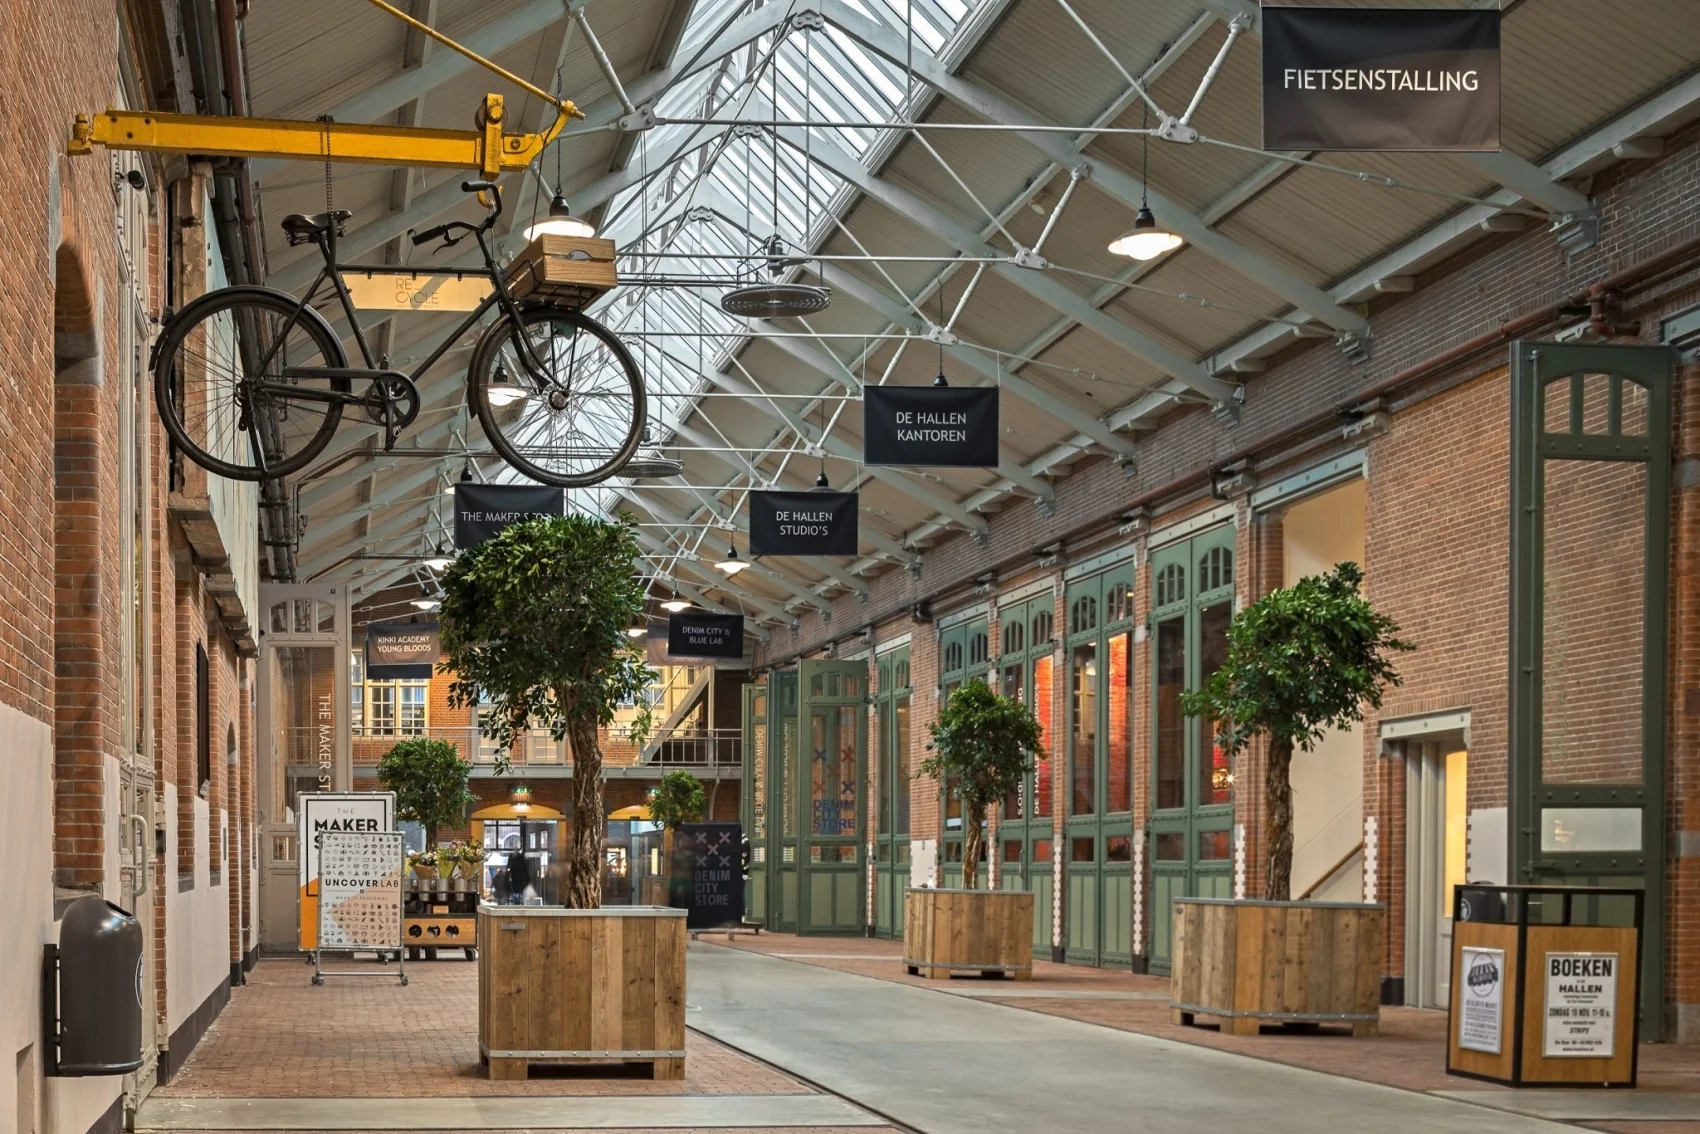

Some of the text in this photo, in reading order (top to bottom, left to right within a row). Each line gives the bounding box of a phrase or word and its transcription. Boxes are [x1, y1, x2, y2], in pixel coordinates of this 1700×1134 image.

[1284, 68, 1479, 91] FIETSENSTALLING
[396, 291, 439, 304] CYCLE
[896, 411, 967, 425] DE HALLEN
[897, 429, 966, 442] KANTOREN
[461, 511, 482, 522] THE
[485, 511, 521, 522] MAKER
[776, 511, 833, 522] DE HALLEN
[780, 525, 828, 536] STUDIO'S
[682, 626, 730, 636] DENIM CITY &
[377, 635, 431, 644] KINKI ACADEMY
[689, 636, 723, 645] BLUE LAB
[377, 644, 431, 653] YOUNG BLOODS
[318, 692, 331, 720] THE
[318, 724, 331, 770] MAKER
[813, 799, 855, 809] DENIM
[1034, 797, 1040, 815] DE
[813, 809, 841, 819] CITY
[314, 818, 379, 832] MAKER
[813, 819, 855, 829] STORE
[694, 870, 731, 881] DENIM
[694, 882, 718, 894] CITY
[695, 894, 729, 906] STORE
[1551, 958, 1612, 977] BOEKEN
[1559, 984, 1603, 993] HALLEN
[1549, 1008, 1570, 1017] ZONDAG
